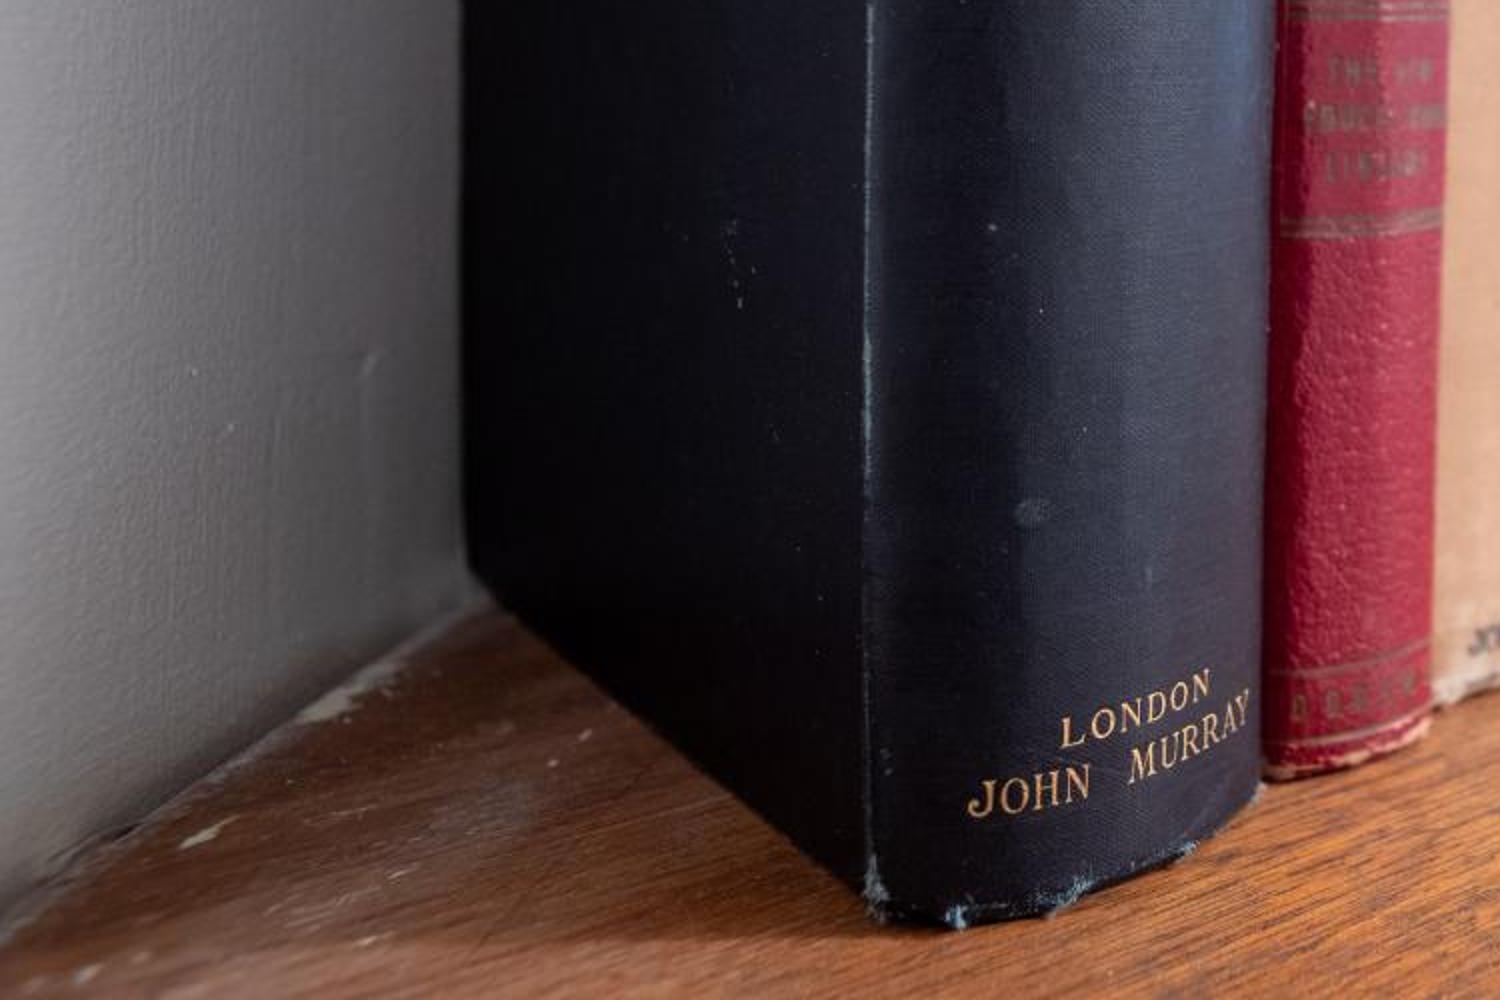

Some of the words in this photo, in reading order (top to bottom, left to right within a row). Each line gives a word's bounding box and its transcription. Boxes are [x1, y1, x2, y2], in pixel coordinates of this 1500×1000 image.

[966, 763, 1091, 819] JOHN
[1126, 687, 1251, 786] MURRAY
[1060, 667, 1213, 750] LONDON
